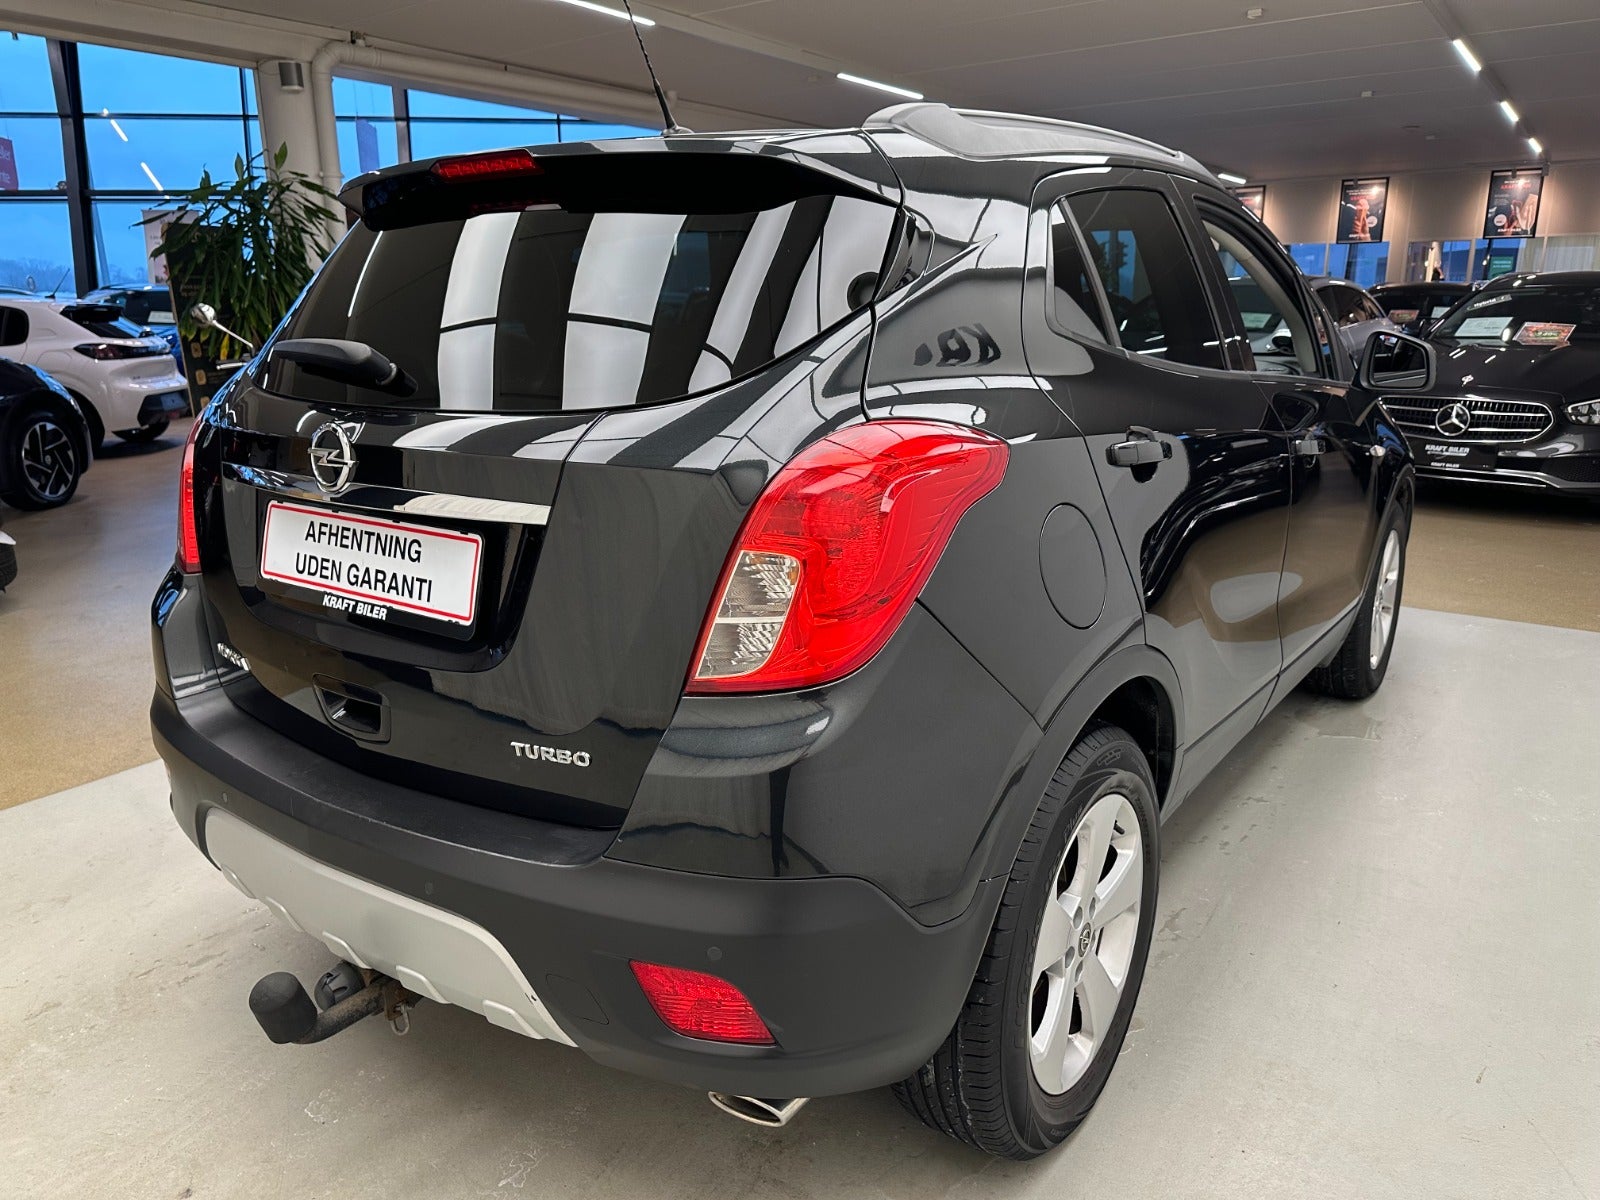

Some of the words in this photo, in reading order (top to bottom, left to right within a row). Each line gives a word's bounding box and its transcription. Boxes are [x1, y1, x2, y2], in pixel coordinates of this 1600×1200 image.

[1425, 444, 1448, 452] KRAFT
[305, 520, 422, 563] AFHENTNING
[295, 552, 342, 583] UDEN
[347, 563, 432, 603] GARANTI
[322, 594, 355, 613] KRAFT
[356, 603, 387, 621] BILER
[510, 741, 592, 767] TURBO
